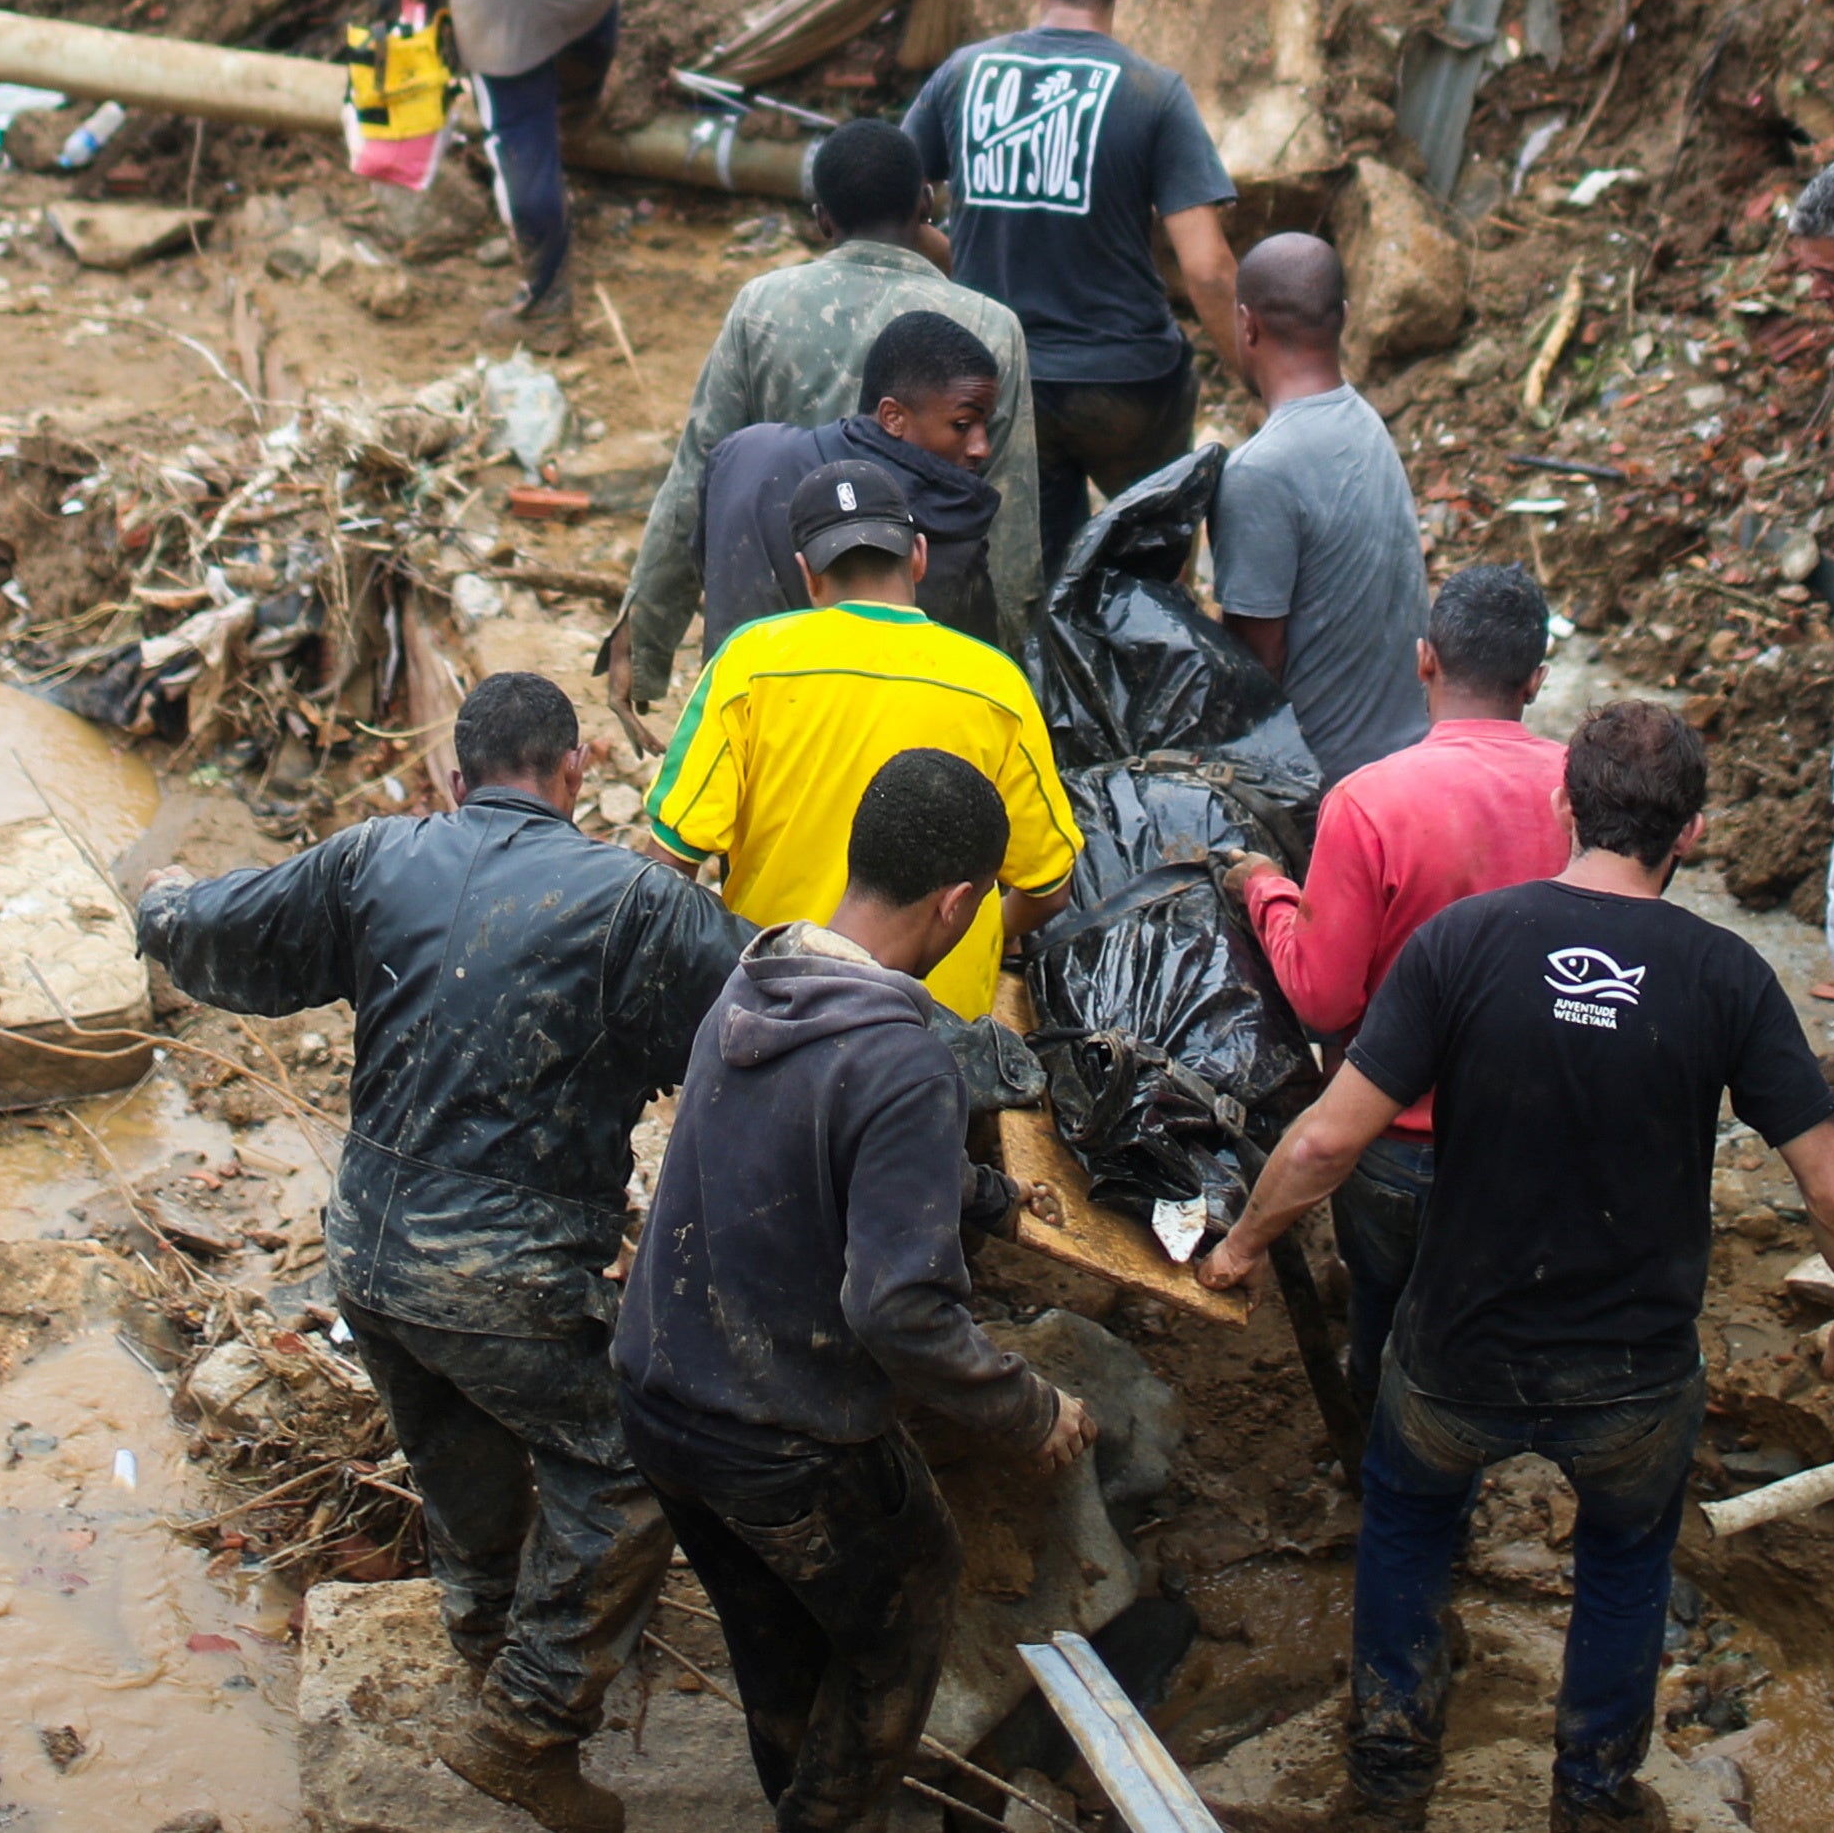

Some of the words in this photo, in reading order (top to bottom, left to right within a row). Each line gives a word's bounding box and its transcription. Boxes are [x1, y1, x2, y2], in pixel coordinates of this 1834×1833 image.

[973, 66, 1022, 142] GO
[972, 92, 1098, 200] OUTSIDE
[1553, 1008, 1618, 1029] WESLEYANA
[1554, 998, 1617, 1018] JUVENTUDE
